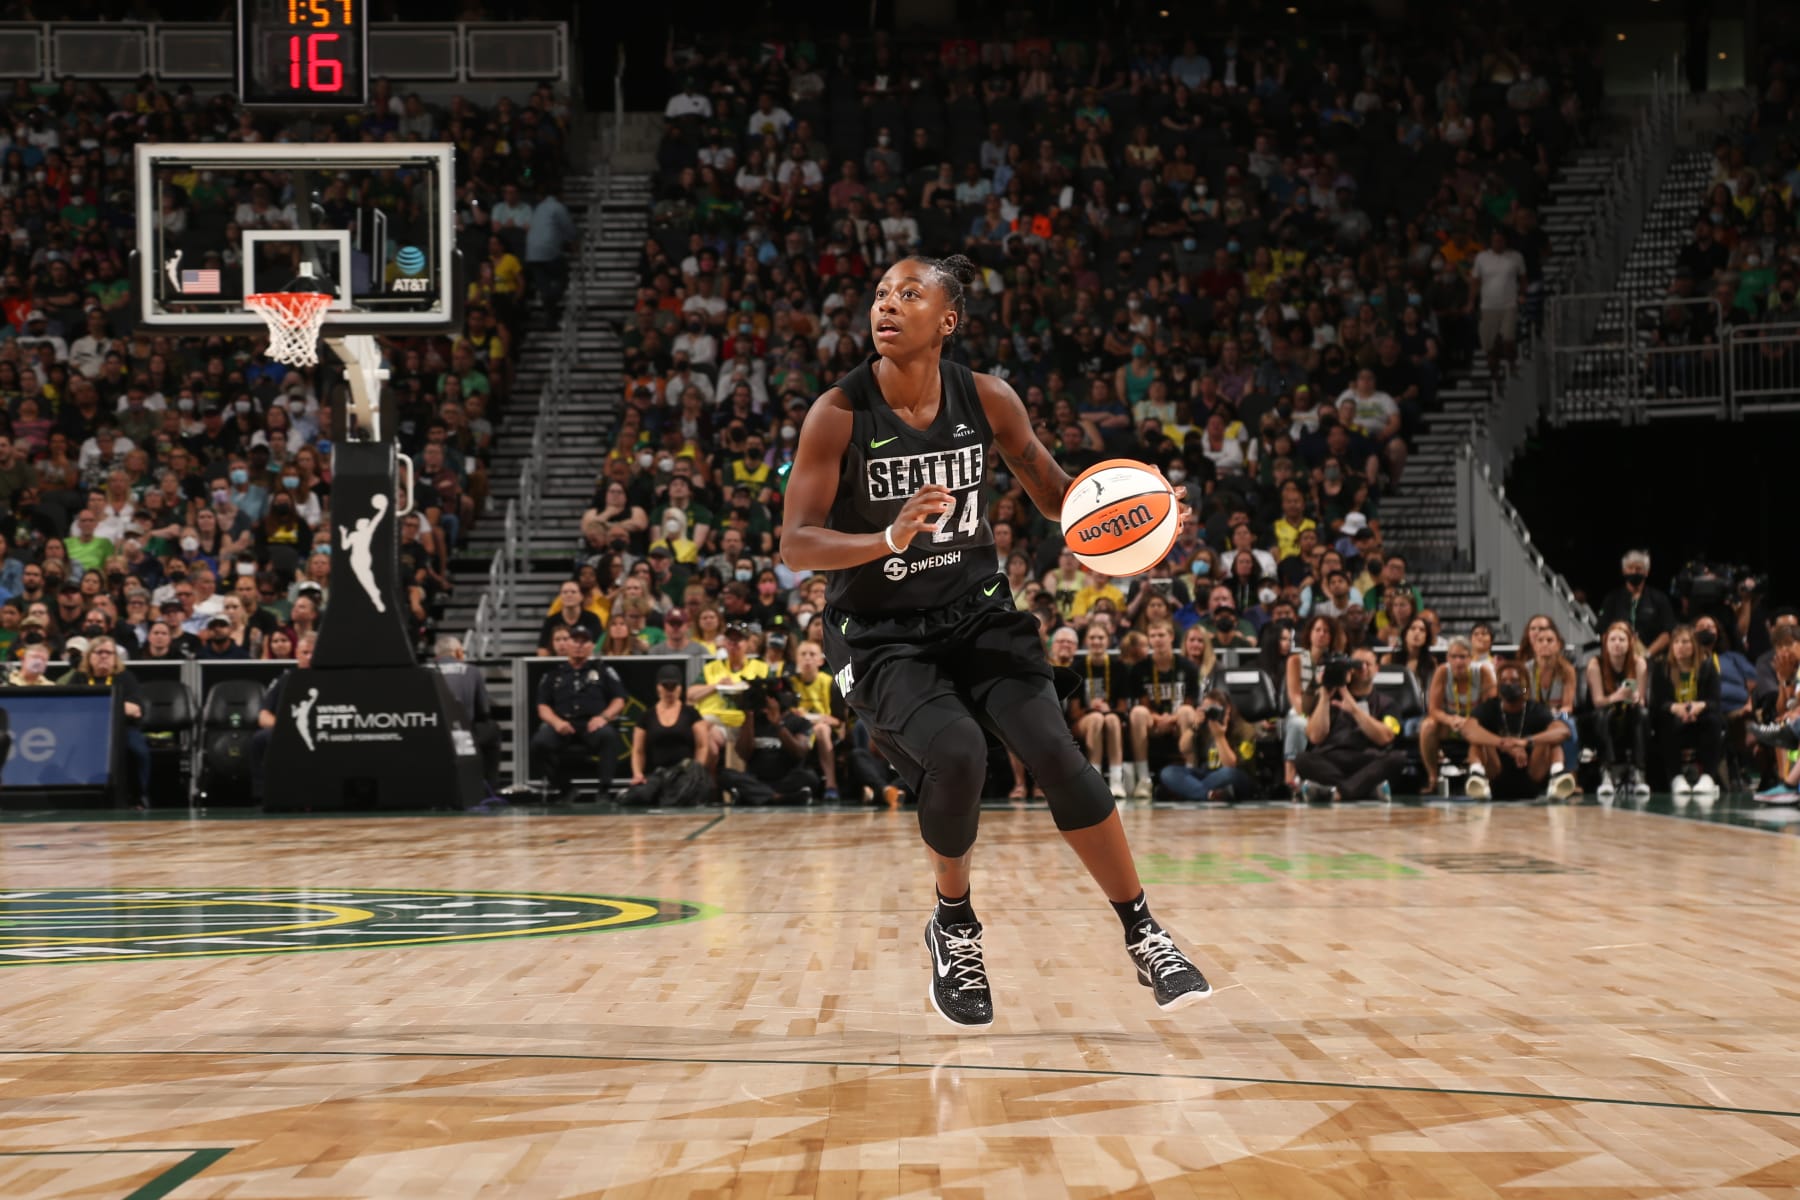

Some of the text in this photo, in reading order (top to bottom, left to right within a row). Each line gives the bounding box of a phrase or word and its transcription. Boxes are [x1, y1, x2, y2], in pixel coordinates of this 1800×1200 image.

[288, 0, 352, 27] 1:57
[290, 33, 343, 92] 16
[392, 278, 430, 292] AT&T
[868, 446, 982, 499] SEATTLE
[932, 490, 980, 543] 24
[1078, 504, 1154, 543] Wilson
[910, 550, 962, 575] SWEDISH
